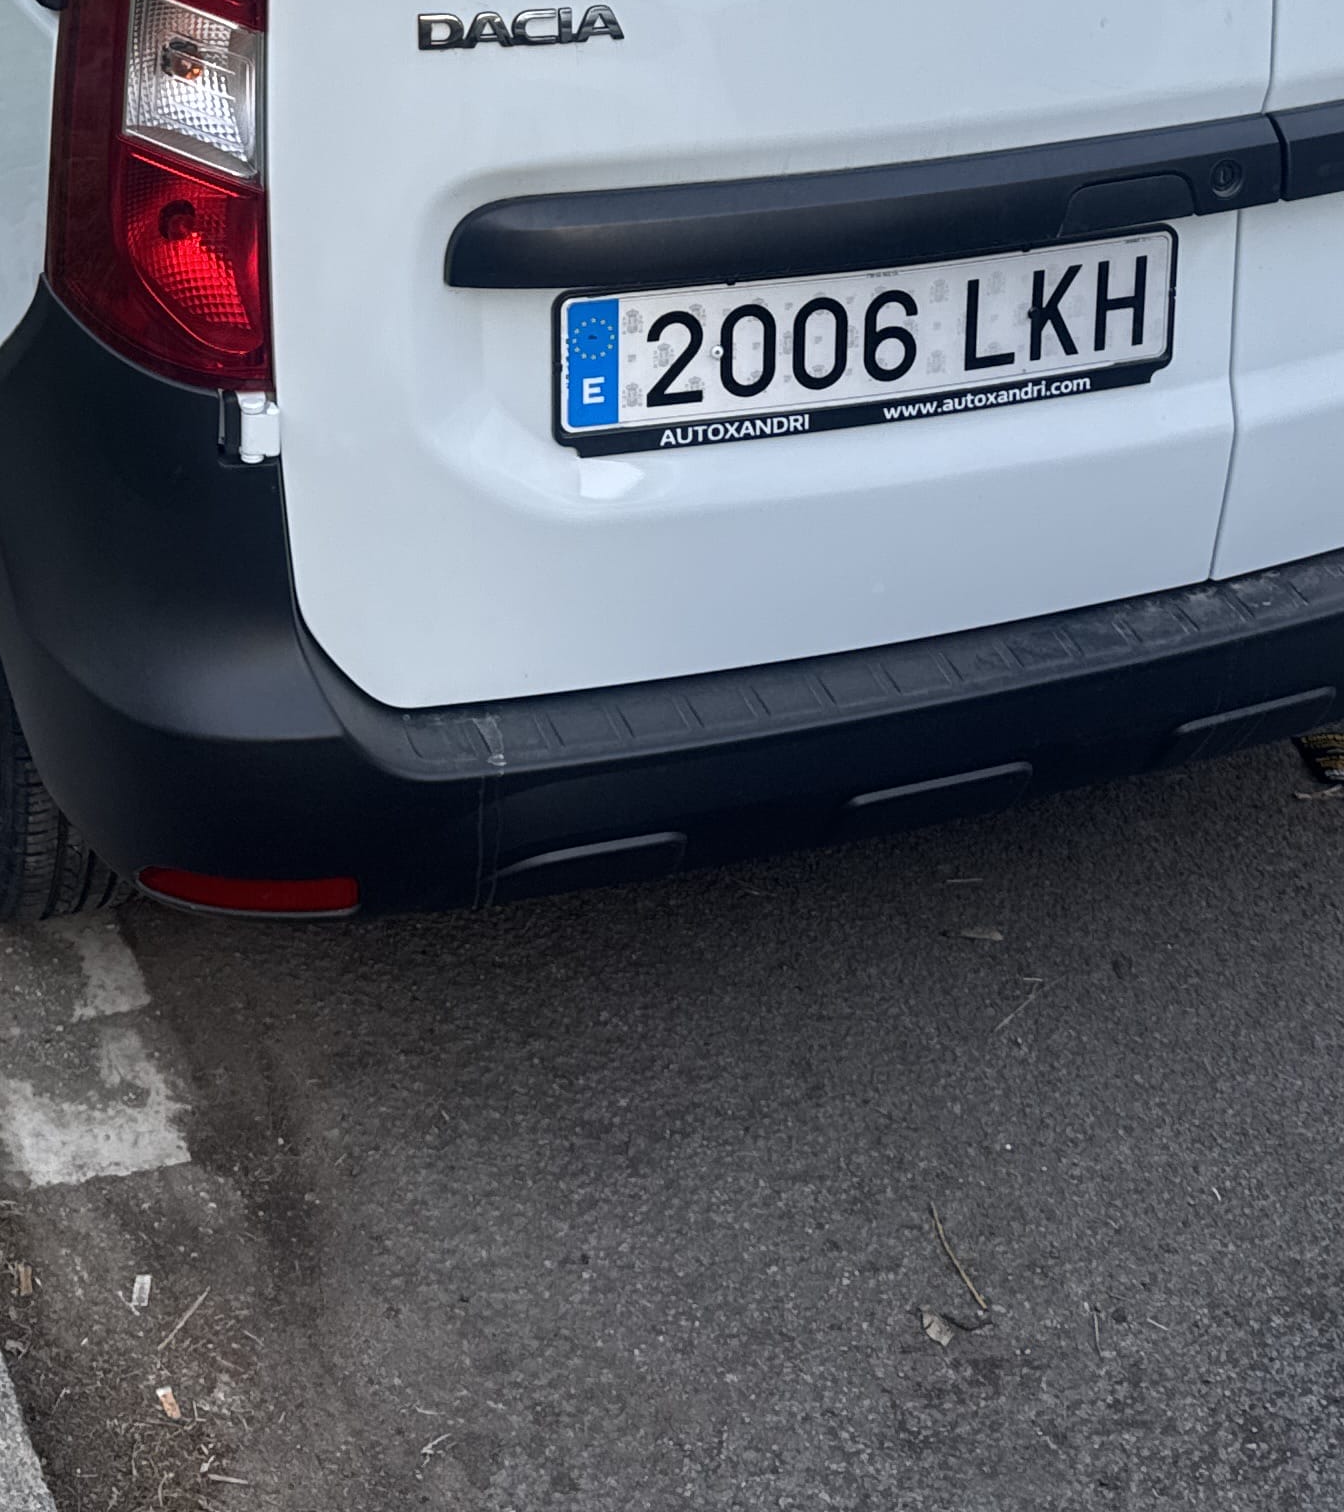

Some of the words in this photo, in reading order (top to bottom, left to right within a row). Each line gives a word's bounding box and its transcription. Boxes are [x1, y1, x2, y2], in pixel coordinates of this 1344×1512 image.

[417, 4, 625, 50] DACIA
[646, 289, 918, 408] 2006
[964, 254, 1149, 371] LKH
[582, 376, 606, 405] E
[883, 374, 1091, 422] www.autoxandri.com
[659, 414, 811, 447] AUTOXANDRI
